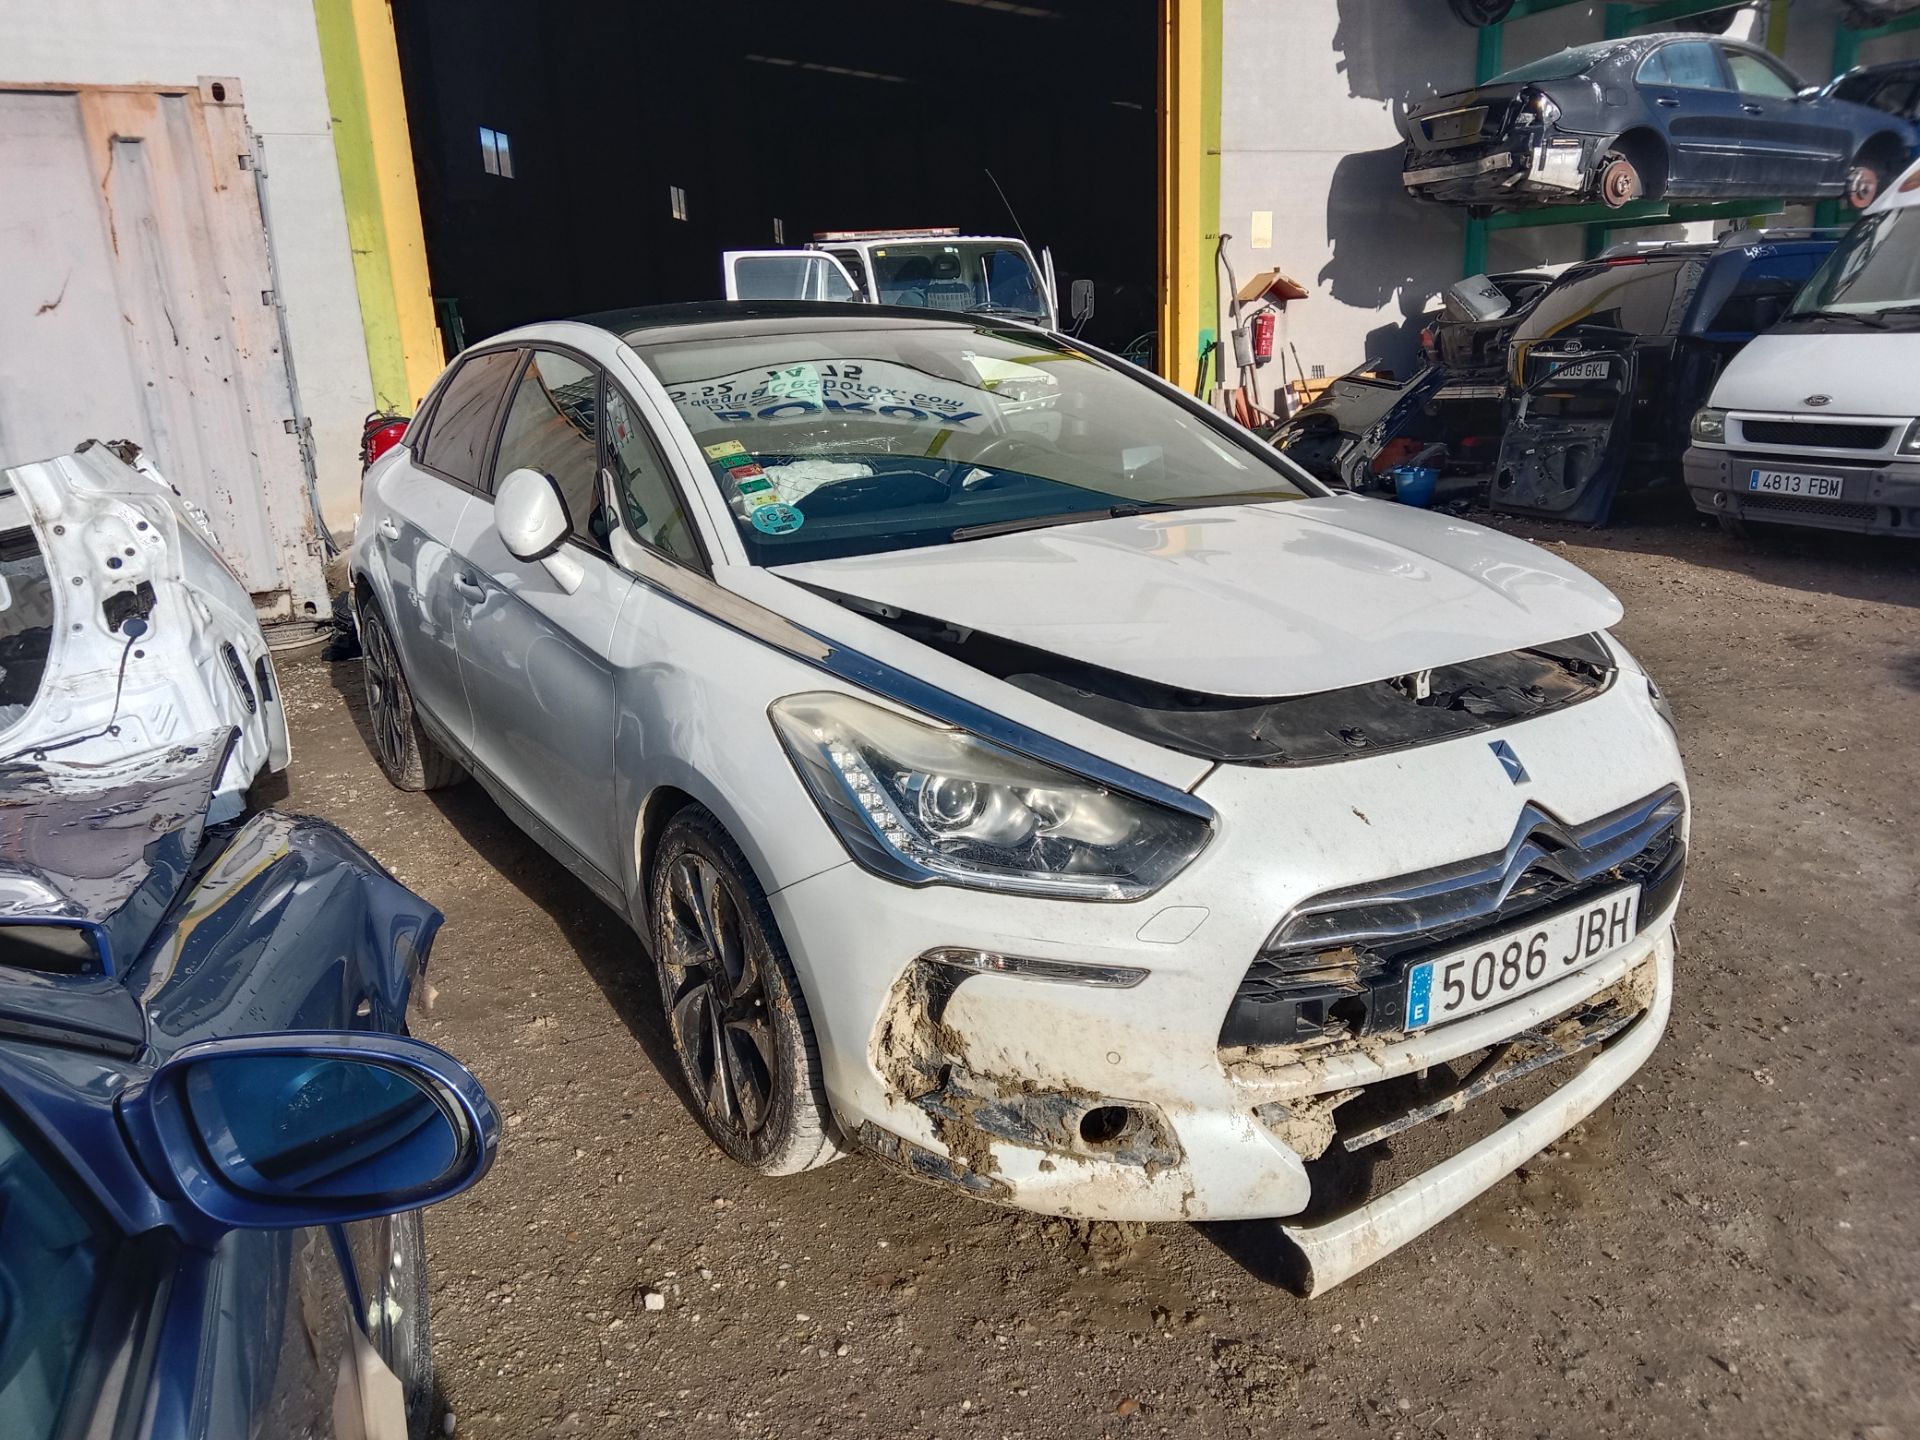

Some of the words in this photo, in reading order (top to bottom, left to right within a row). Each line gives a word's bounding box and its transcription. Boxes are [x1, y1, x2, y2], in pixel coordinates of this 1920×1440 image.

[1557, 363, 1582, 377] 009
[1585, 363, 1606, 377] GKL
[1762, 474, 1802, 492] 4813
[1808, 477, 1840, 497] FBM
[1443, 931, 1549, 1011] 5086
[1563, 896, 1632, 966] JBH
[1414, 1003, 1424, 1020] E
